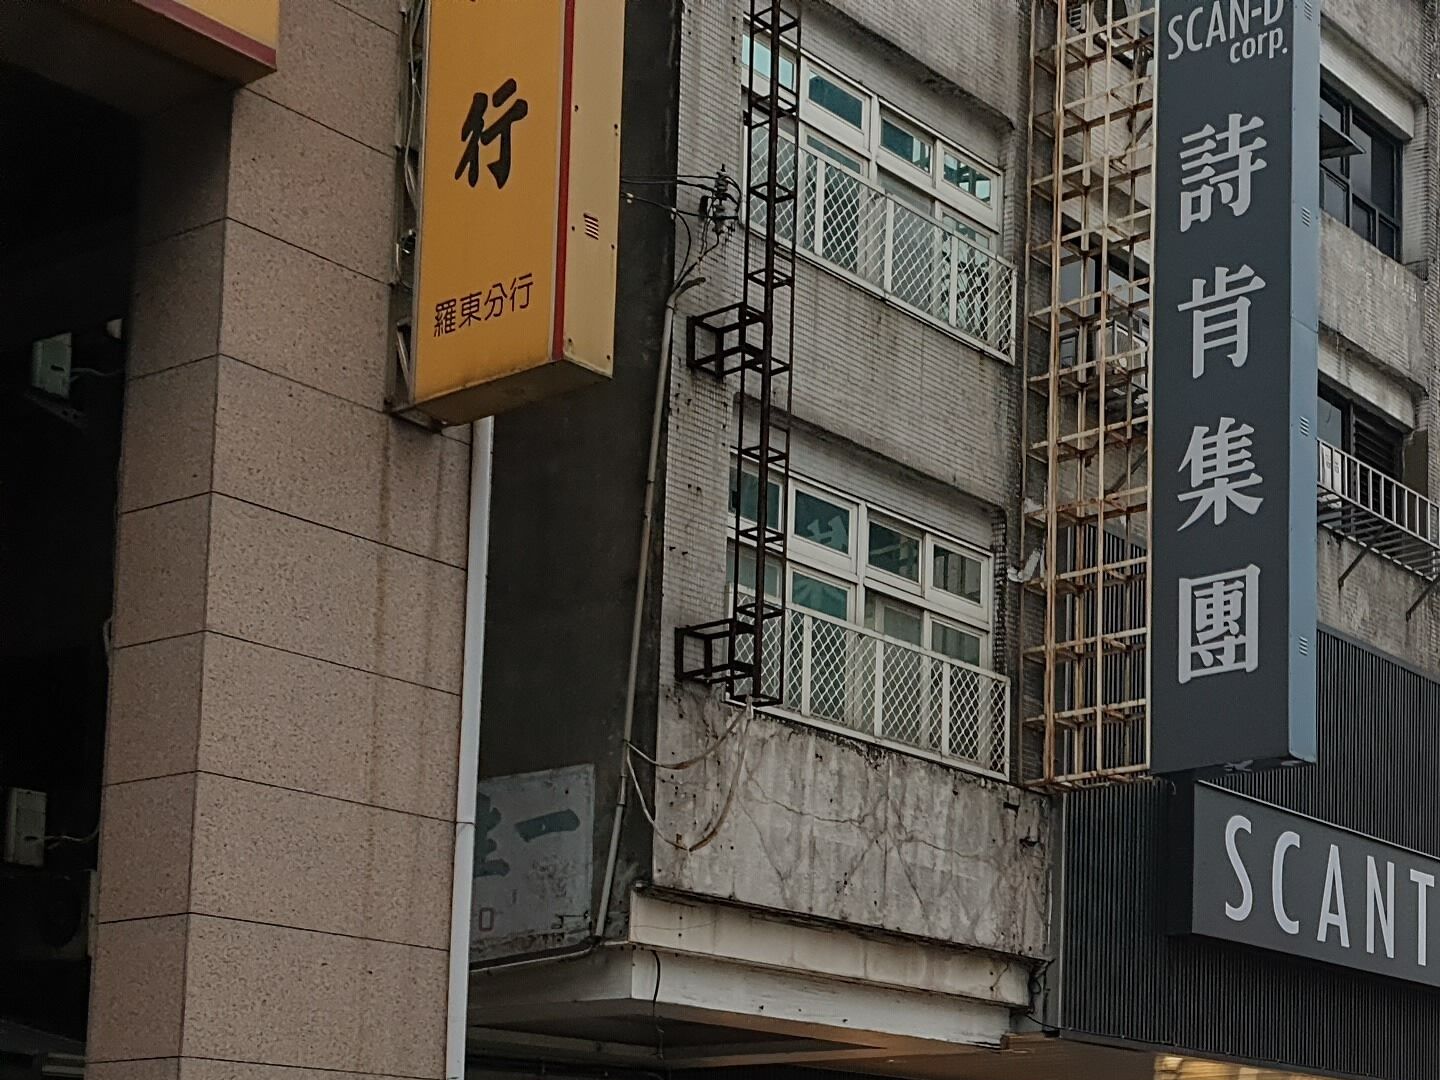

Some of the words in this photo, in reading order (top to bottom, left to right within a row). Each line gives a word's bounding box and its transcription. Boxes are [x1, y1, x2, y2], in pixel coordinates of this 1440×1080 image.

[1168, 0, 1283, 60] SCAN-D
[1229, 27, 1288, 63] corp.
[454, 78, 529, 189] 行
[433, 272, 533, 338] 羅東分行
[1177, 113, 1268, 684] 詩肯集團
